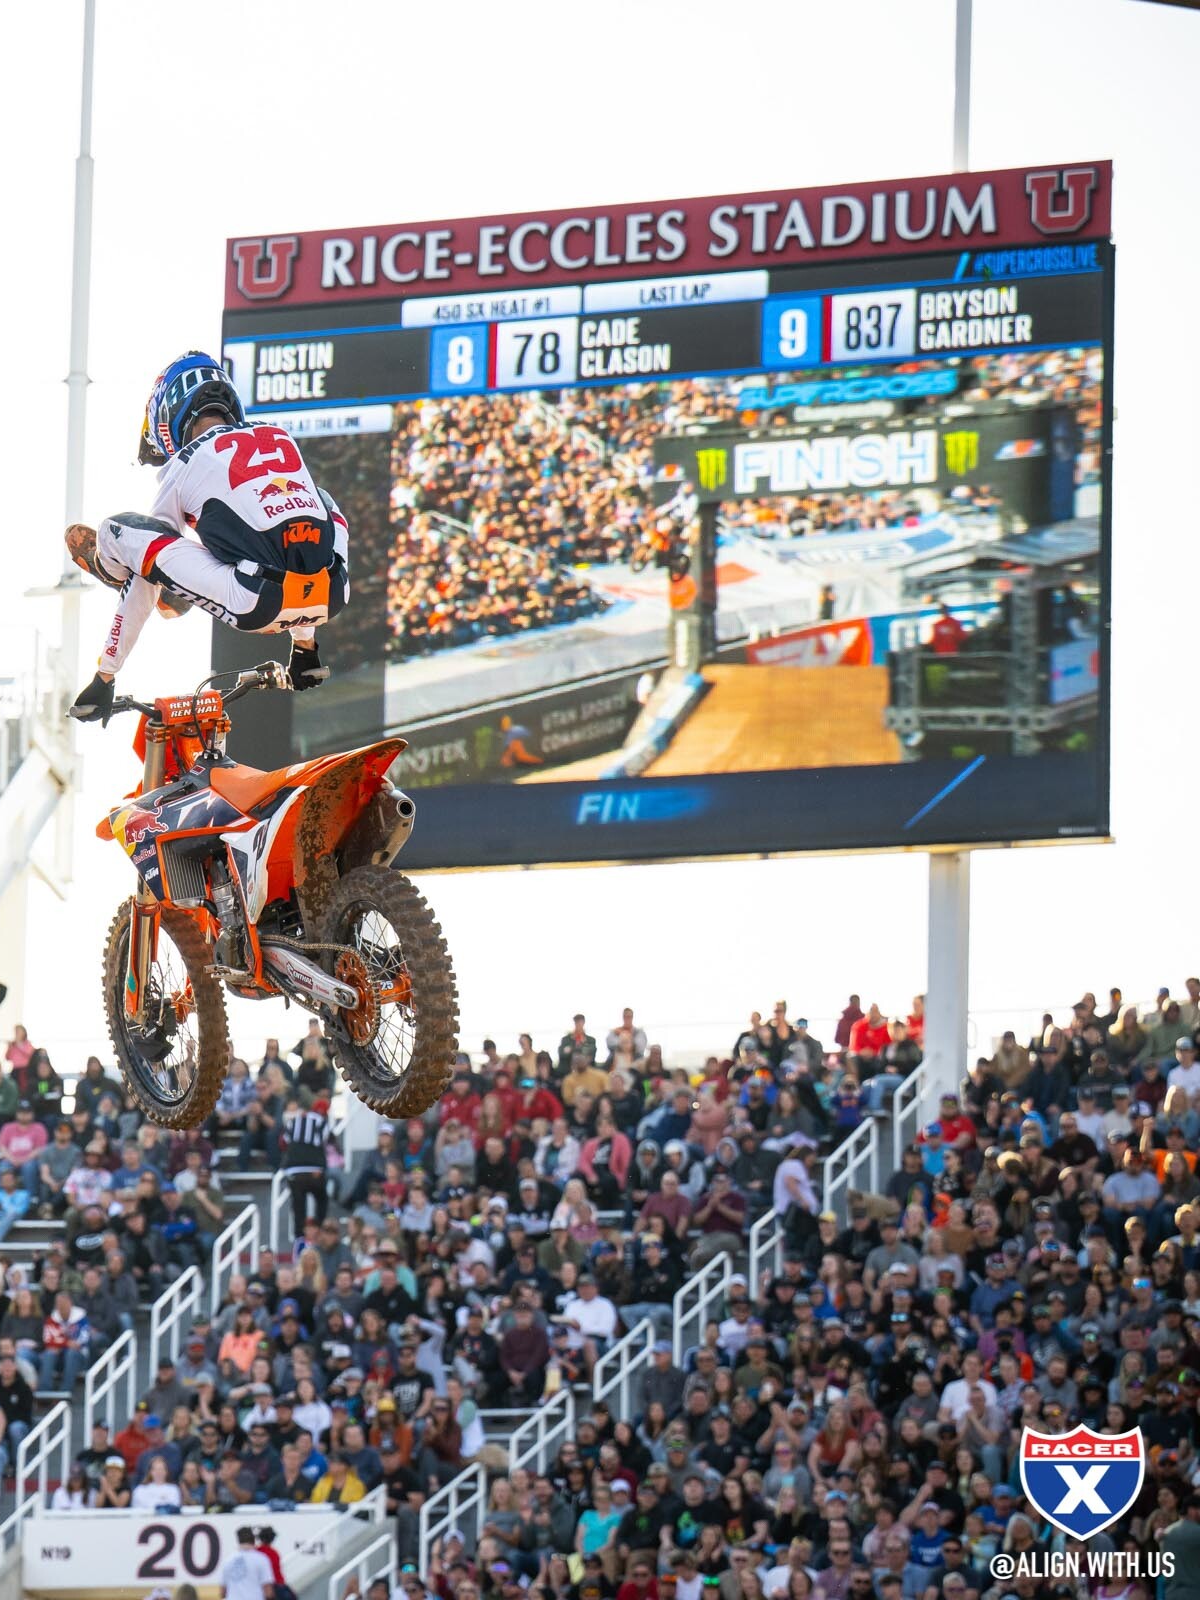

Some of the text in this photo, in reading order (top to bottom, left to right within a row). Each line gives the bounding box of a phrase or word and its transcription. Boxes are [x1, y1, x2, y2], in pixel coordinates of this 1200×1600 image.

[321, 183, 997, 289] RICE-ECCLES STADIUM
[433, 297, 551, 321] 450 SX HEAT #1
[639, 283, 711, 305] LAST LAP
[920, 286, 1017, 321] BRYSON
[581, 317, 641, 349] CADE
[779, 308, 808, 358] 9
[845, 303, 902, 350] 837
[919, 314, 1032, 351] GARDNER
[257, 341, 334, 374] JUSTIN
[446, 335, 475, 385] 8
[511, 331, 561, 377] 78
[580, 343, 671, 378] CLASON
[257, 371, 327, 402] BOGLE
[737, 370, 959, 410] SUPERCROSS
[215, 426, 302, 491] 25
[734, 429, 939, 494] FINISH
[263, 497, 320, 519] Red Bull
[283, 521, 321, 549] KTM
[111, 614, 124, 637] Bull
[170, 697, 218, 709] RENHAL
[145, 868, 158, 881] KTM
[381, 980, 394, 990] 25
[137, 1523, 221, 1579] 20
